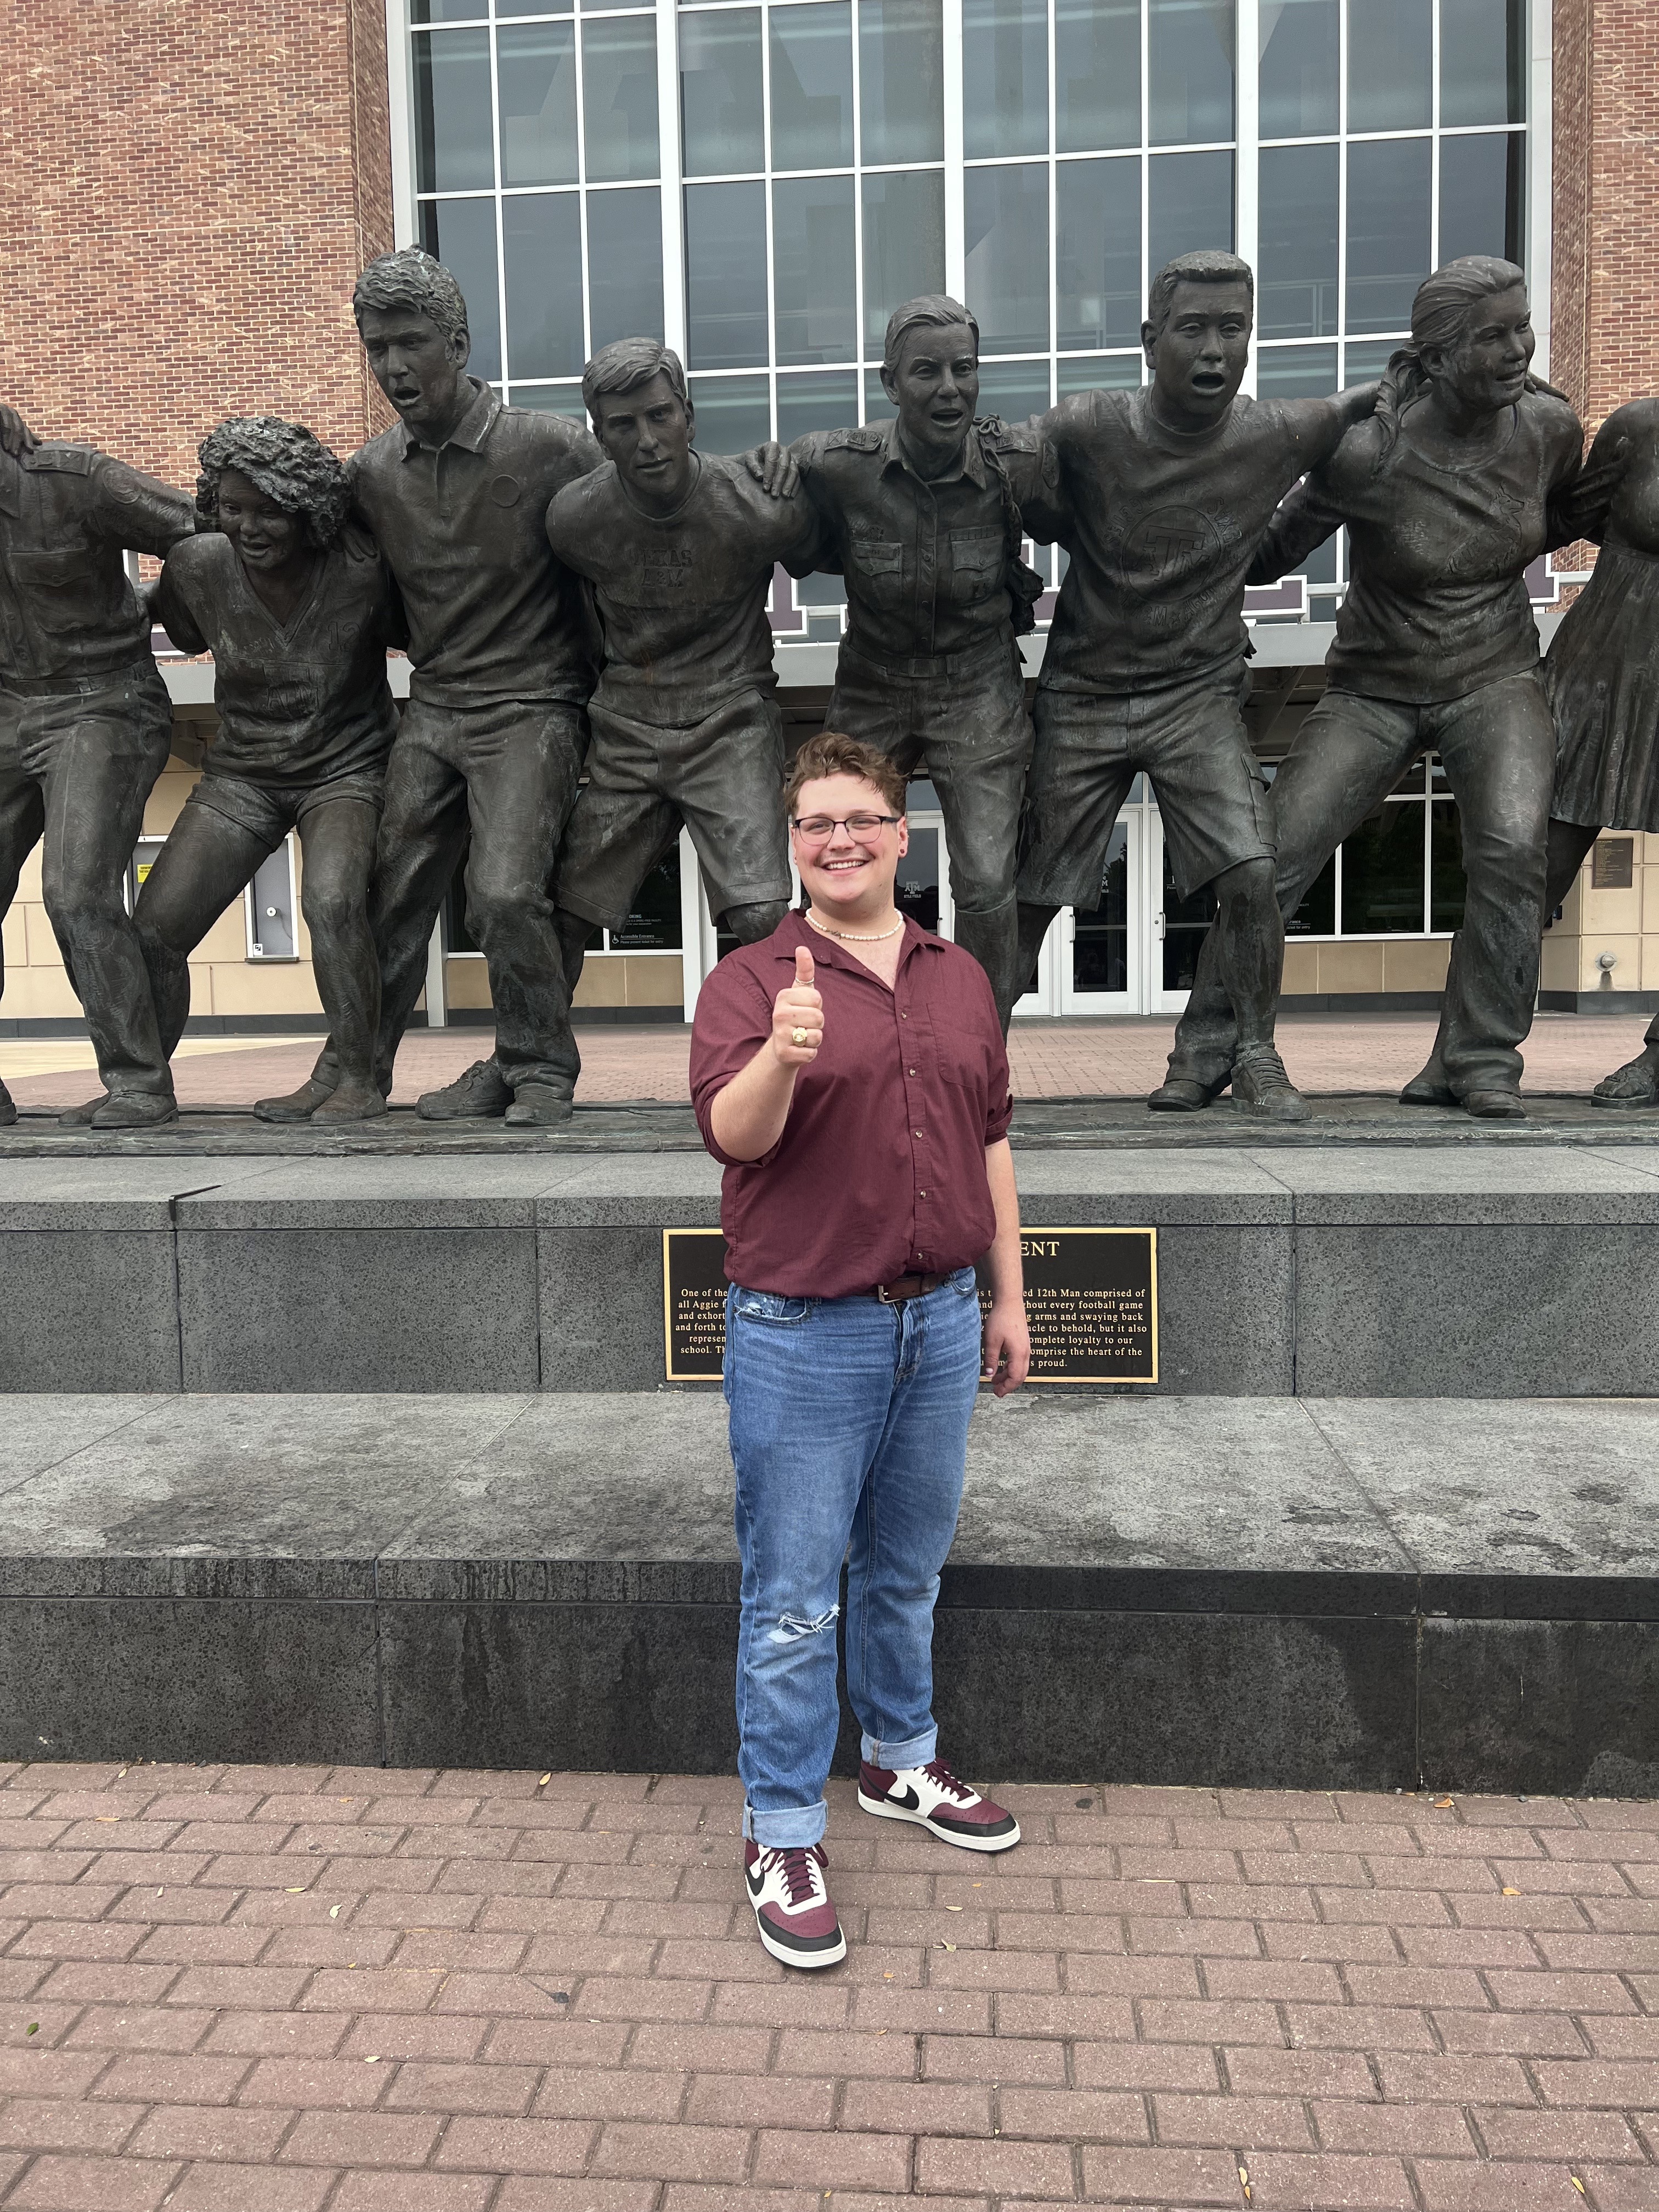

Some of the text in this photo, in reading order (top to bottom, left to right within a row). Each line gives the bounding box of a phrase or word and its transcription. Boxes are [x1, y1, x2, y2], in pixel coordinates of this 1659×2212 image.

[1020, 1242, 1060, 1256] ENT
[681, 1289, 698, 1297] One
[702, 1289, 712, 1297] of
[714, 1289, 727, 1297] the
[1037, 1288, 1057, 1297] 12th
[1060, 1289, 1080, 1297] Man
[1084, 1288, 1132, 1299] comprised
[1135, 1289, 1146, 1297] of
[678, 1300, 690, 1308] all
[692, 1300, 719, 1310] Aggie
[1026, 1300, 1047, 1309] hout
[1049, 1302, 1075, 1311] every
[1079, 1300, 1115, 1309] football
[1119, 1302, 1143, 1311] game
[679, 1311, 694, 1319] and
[697, 1311, 725, 1319] exhort
[1060, 1312, 1076, 1321] and
[1080, 1312, 1118, 1323] swaying
[1121, 1312, 1144, 1321] back
[675, 1323, 691, 1331] and
[694, 1322, 716, 1331] forth
[1029, 1323, 1046, 1332] acle
[1061, 1324, 1096, 1334] behold,
[1099, 1324, 1114, 1332] but
[1118, 1324, 1125, 1332] it
[1128, 1324, 1147, 1333] also
[1030, 1335, 1065, 1346] omplete
[1069, 1335, 1101, 1346] loyalty
[680, 1345, 712, 1353] school.
[1030, 1347, 1066, 1357] omprise
[1070, 1347, 1084, 1356] the
[1087, 1347, 1111, 1356] heart
[1115, 1347, 1125, 1356] of
[1128, 1347, 1143, 1356] the
[1038, 1358, 1068, 1369] proud.
